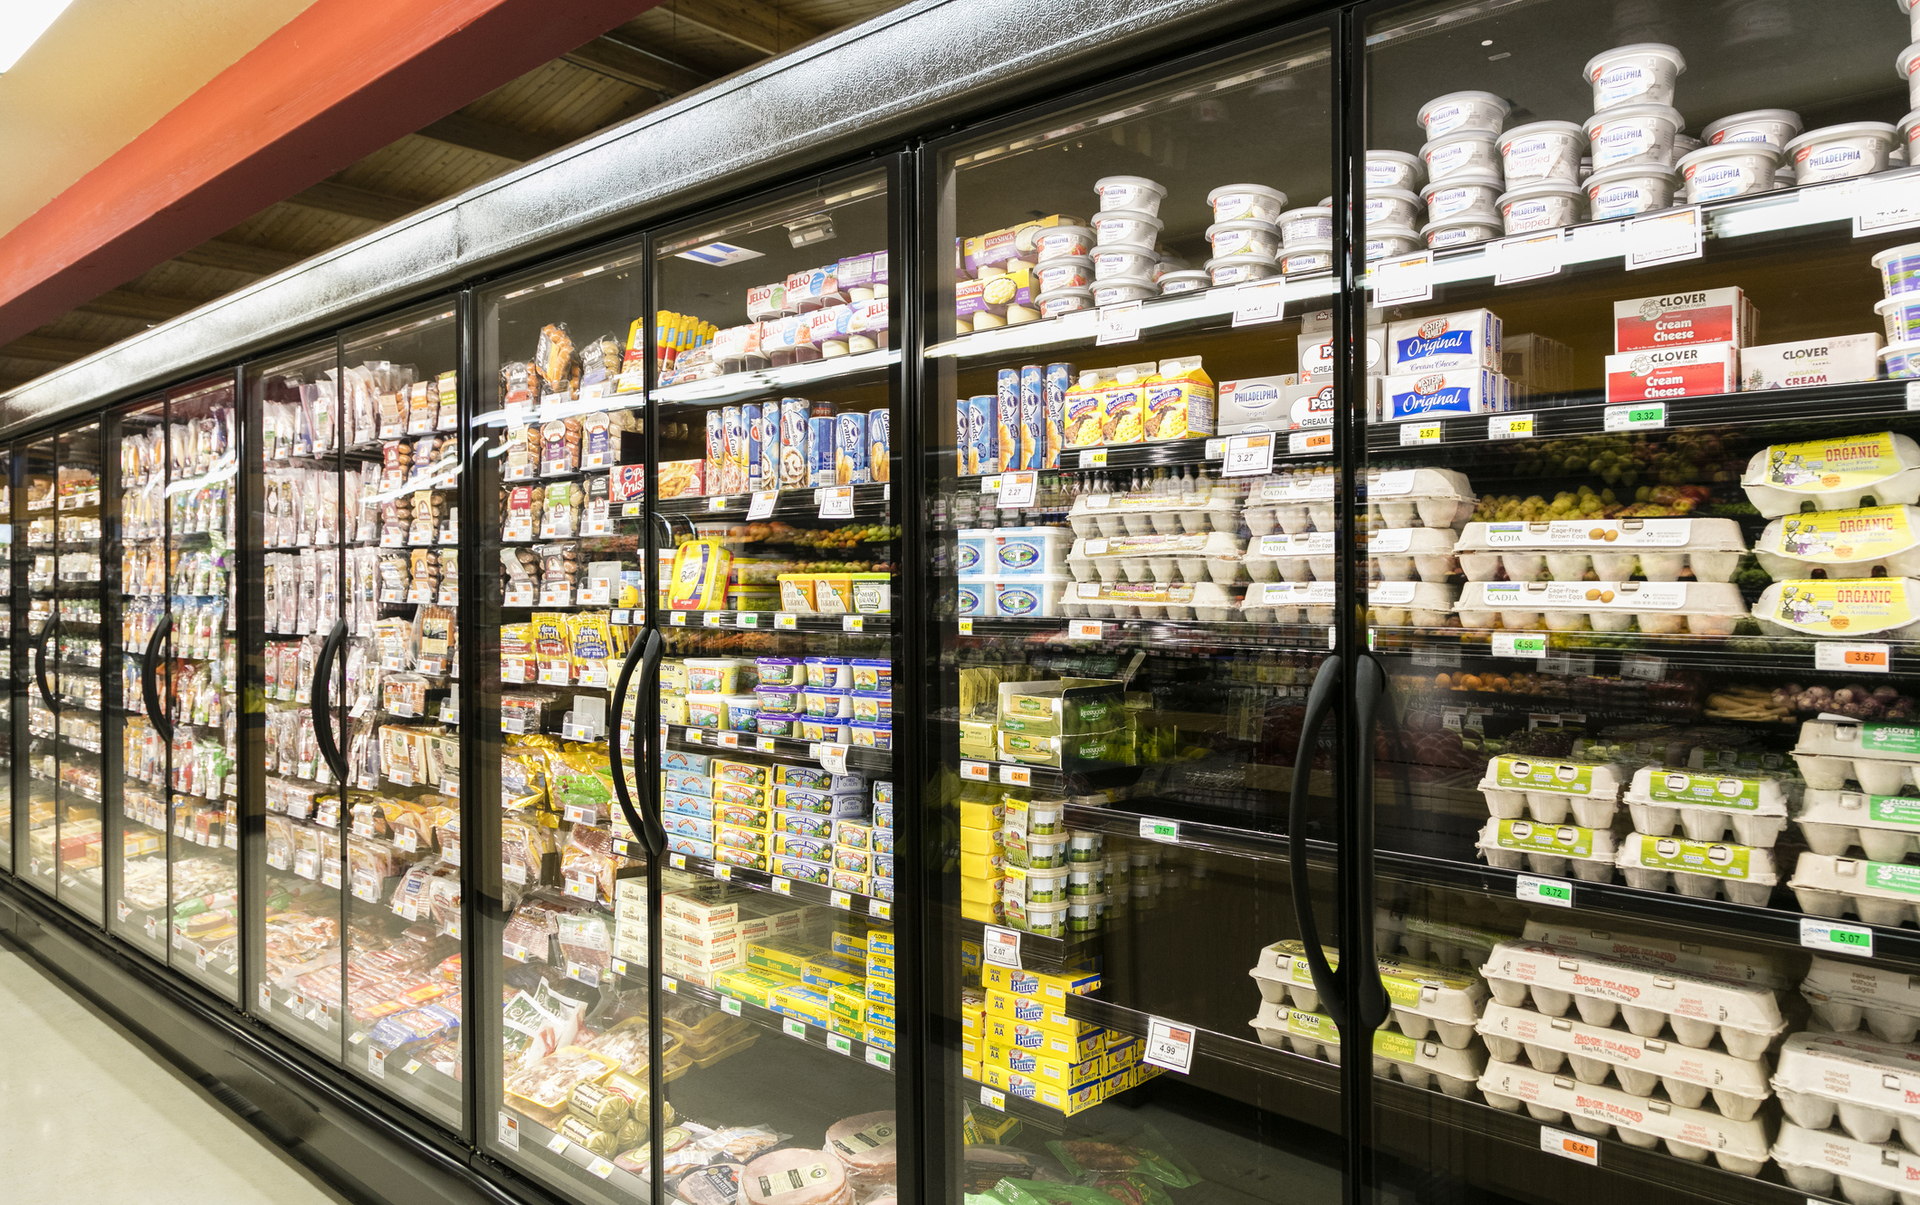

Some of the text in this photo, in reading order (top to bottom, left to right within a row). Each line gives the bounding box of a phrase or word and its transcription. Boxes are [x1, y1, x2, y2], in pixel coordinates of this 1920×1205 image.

[1600, 68, 1642, 89] PHILADELPHIA
[1430, 108, 1460, 124] PHILADELPHIA
[1600, 128, 1642, 148] PHILADELPHIA
[1432, 147, 1462, 162] PHILADELPHIA
[1511, 142, 1546, 156] PHILADELPHIA
[1809, 150, 1861, 168] PHILADELPHIA
[1694, 167, 1740, 188] PHILADELPHIA
[1435, 190, 1466, 204] PHILADELPHIA
[1598, 190, 1640, 208] PHILADELPHIA
[1511, 204, 1546, 218] PHILADELPHIA
[1435, 230, 1466, 242] PHILADELPHIA
[1659, 292, 1706, 308] CLOVER
[1420, 317, 1448, 334] WESTERN
[1655, 320, 1692, 331] Cream
[1424, 327, 1444, 340] FAMILY
[1653, 330, 1694, 342] Cheese
[1406, 332, 1464, 362] Original
[1651, 350, 1698, 363] CLOVER
[1782, 346, 1828, 360] CLOVER
[1410, 358, 1460, 372] Cream Cheese
[1788, 368, 1824, 378] ORGANIC
[1416, 374, 1445, 390] WESTERN
[1646, 376, 1684, 386] Cream
[1784, 374, 1828, 386] CREAM
[1420, 383, 1441, 396] FAMILY
[1644, 386, 1686, 398] Cheese
[1048, 380, 1059, 419] Crescent
[1234, 389, 1278, 403] PHILADELPHIA
[1000, 386, 1012, 423] Crescent
[1021, 384, 1032, 422] Crescent
[1402, 388, 1462, 417] Original
[1302, 417, 1324, 426] CREAM
[1636, 412, 1654, 420] 3.32
[1510, 422, 1526, 431] 2.57
[842, 418, 855, 452] Grands!
[1420, 430, 1434, 438] 2.57
[1236, 453, 1254, 463] 3.27
[1826, 444, 1880, 462] ORGANIC
[1836, 458, 1873, 468] Cage Free
[1008, 488, 1022, 496] 2.27
[1840, 518, 1894, 533] ORGANIC
[1490, 534, 1521, 542] CADIA
[859, 590, 877, 598] SMART
[1487, 594, 1519, 602] CADIA
[1837, 590, 1892, 604] ORGANIC
[820, 600, 840, 608] balance
[1517, 641, 1534, 649] 4.58
[1854, 653, 1876, 662] 3.67
[702, 668, 724, 678] BUTTER
[1884, 726, 1915, 735] CLOVER
[786, 769, 806, 778] CHALLENGE
[786, 792, 806, 802] CHALLENGE
[785, 816, 819, 830] CHALLENGE BUTTER
[1158, 827, 1170, 835] 7.57
[785, 840, 806, 848] CHALLENGE
[1546, 888, 1563, 898] 3.72
[710, 906, 732, 916] Tillamook
[713, 928, 735, 938] Tillamook
[1840, 933, 1860, 944] 5.07
[712, 948, 734, 959] Tillamook
[846, 947, 862, 956] Sweet
[870, 946, 885, 954] Sweet
[993, 948, 1006, 956] 2.07
[767, 960, 782, 970] Butter
[1518, 962, 1537, 970] raised
[869, 968, 884, 978] Sweet
[990, 968, 1002, 976] GRADE
[1516, 968, 1538, 978] without
[1852, 972, 1876, 982] raised
[990, 974, 1000, 983] AA
[1516, 974, 1534, 982] cages
[1850, 978, 1878, 988] without
[1010, 980, 1039, 995] Butter
[1573, 973, 1641, 998] ROCK ISLAND
[1852, 984, 1876, 995] cages
[868, 992, 884, 1002] Sweet
[1681, 996, 1702, 1006] raised
[835, 1004, 852, 1016] Butter
[994, 1002, 1004, 1010] AA
[1678, 1003, 1705, 1012] without
[783, 1008, 813, 1024] Sweet Butter
[868, 1016, 883, 1024] Sweet
[1015, 1007, 1044, 1022] Butter
[1292, 1012, 1320, 1024] CLOVER
[1519, 1020, 1538, 1029] raised
[994, 1028, 1004, 1036] AA
[1516, 1026, 1538, 1035] without
[1518, 1032, 1536, 1040] cages
[1015, 1033, 1044, 1049] Butter
[1396, 1037, 1409, 1046] SEFS
[1574, 1032, 1642, 1060] ROCK ISLAND
[1160, 1044, 1176, 1056] 4.99
[1382, 1042, 1412, 1055] COMPLIANT
[990, 1051, 1000, 1060] AA
[1009, 1058, 1036, 1074] Butter
[1682, 1058, 1703, 1068] raised
[1679, 1065, 1705, 1076] without
[1825, 1070, 1850, 1080] raised
[990, 1076, 999, 1085] AA
[1520, 1080, 1539, 1090] raised
[1823, 1076, 1852, 1087] without
[1518, 1086, 1540, 1095] without
[1825, 1082, 1849, 1094] cages
[1519, 1092, 1537, 1101] cages
[574, 1095, 592, 1110] Regular
[1576, 1095, 1644, 1123] ROCK ISLAND
[1684, 1122, 1706, 1132] raised
[1682, 1129, 1708, 1140] without
[1572, 1142, 1590, 1154] 6.47
[1825, 1142, 1850, 1153] raised
[1823, 1148, 1852, 1161] without
[1825, 1156, 1850, 1168] cages
